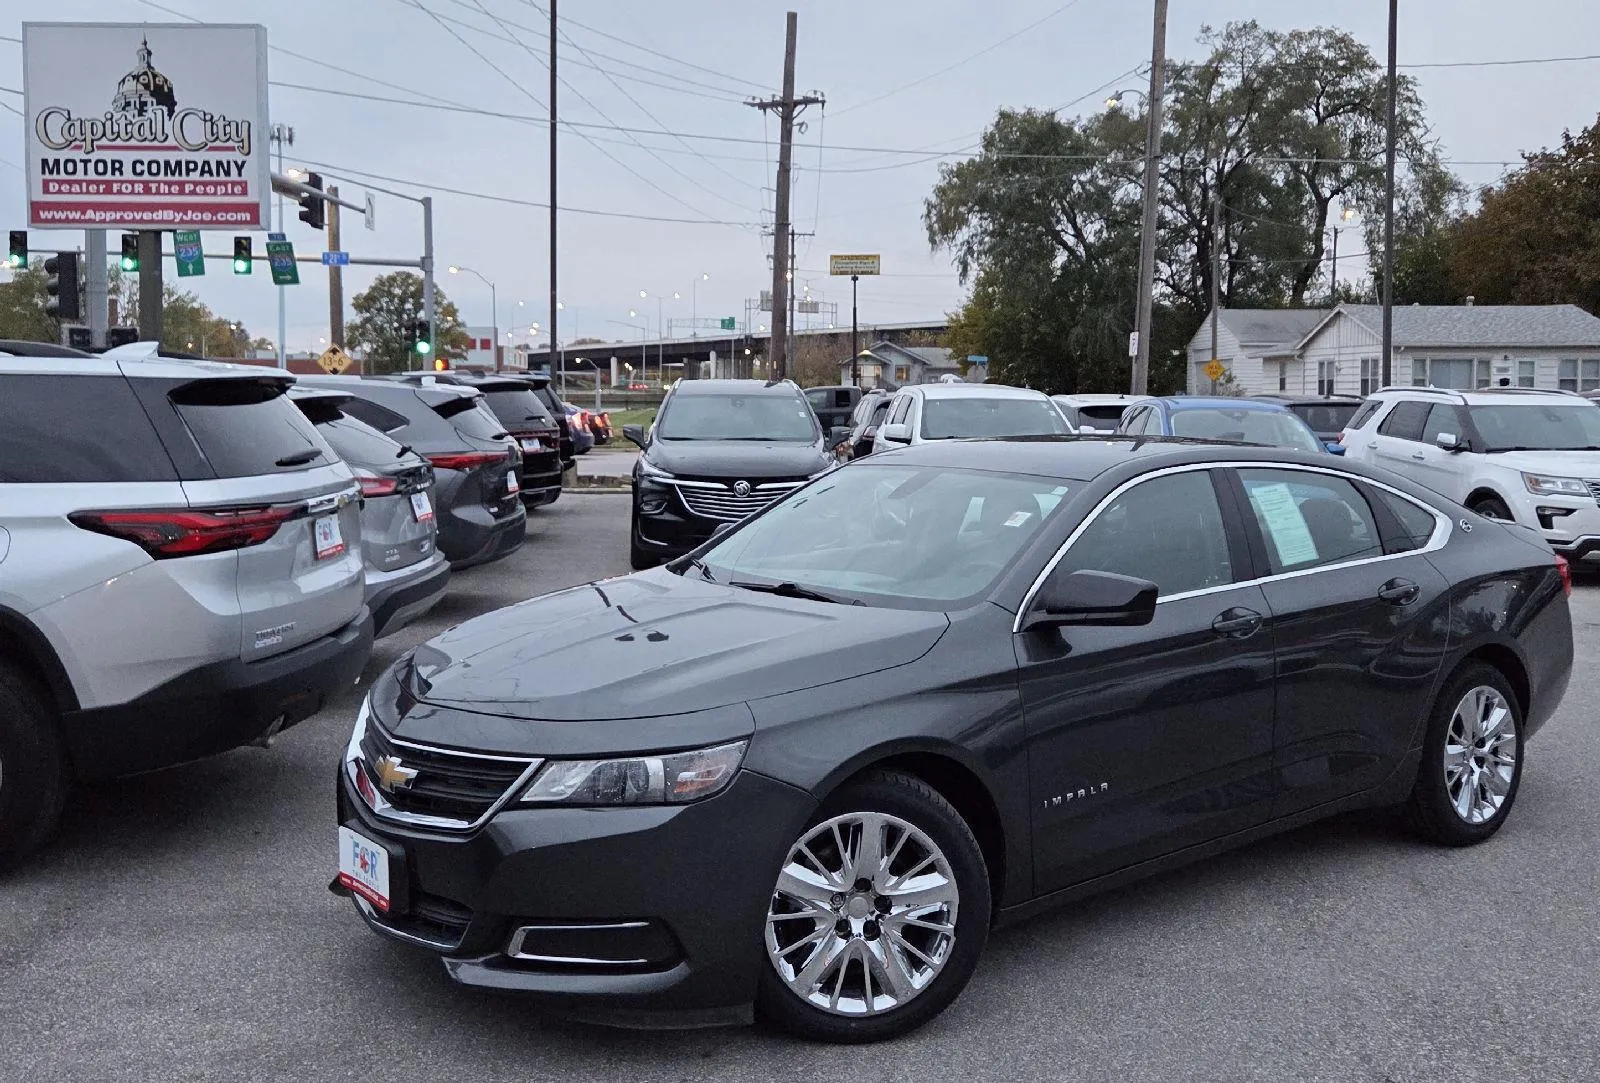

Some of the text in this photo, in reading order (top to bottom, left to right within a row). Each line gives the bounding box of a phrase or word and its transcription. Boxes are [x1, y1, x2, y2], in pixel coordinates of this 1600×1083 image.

[36, 106, 252, 156] Capital City
[41, 158, 247, 178] MOTOR COMPANY
[49, 181, 242, 196] Dealer FOR The People
[39, 208, 251, 222] www.ApprovedByJoe.com
[180, 246, 200, 257] 235
[1043, 782, 1109, 809] IMPALA
